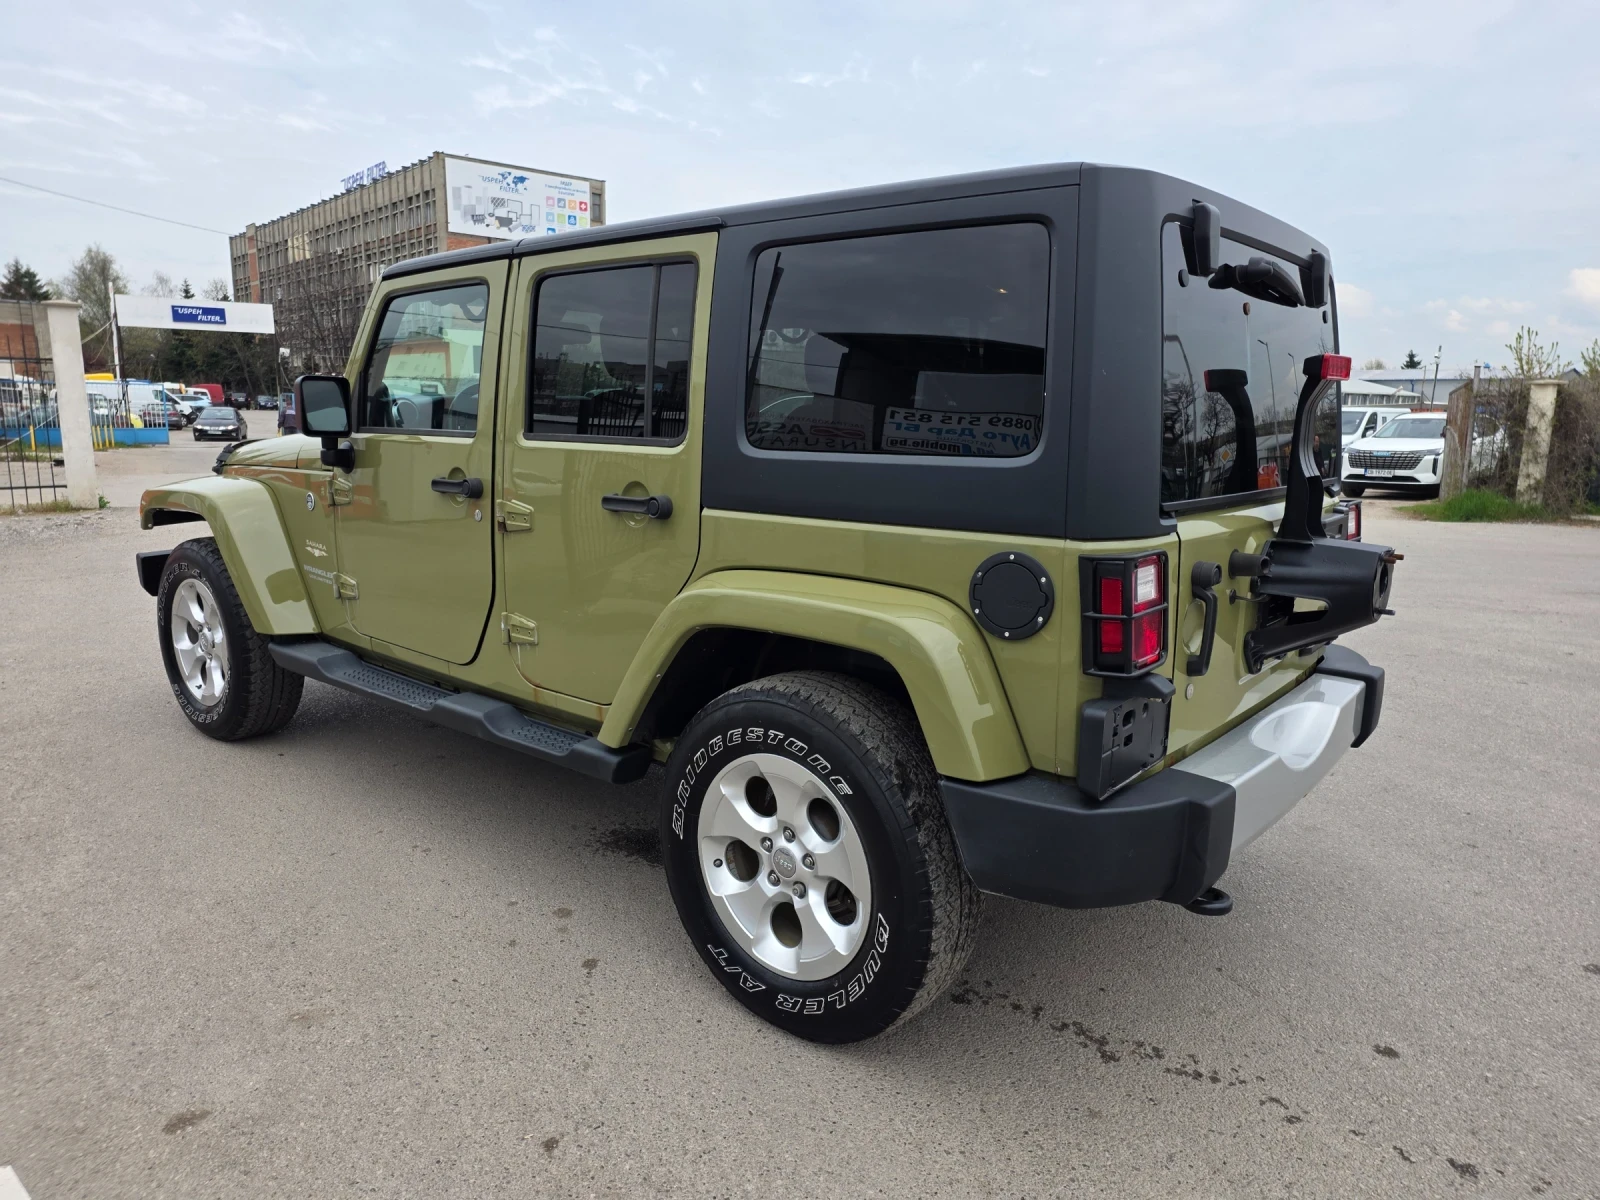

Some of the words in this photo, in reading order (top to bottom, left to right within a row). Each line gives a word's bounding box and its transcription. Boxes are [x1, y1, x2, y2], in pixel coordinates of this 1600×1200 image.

[366, 160, 387, 184] FILTER
[481, 175, 504, 185] USPEH
[499, 185, 520, 194] FILTER
[177, 307, 203, 315] USPEH
[306, 539, 327, 551] SAHARA
[672, 727, 853, 840] BRIDGESTONE
[707, 943, 766, 992] A/T
[775, 912, 890, 1015] DUELER
